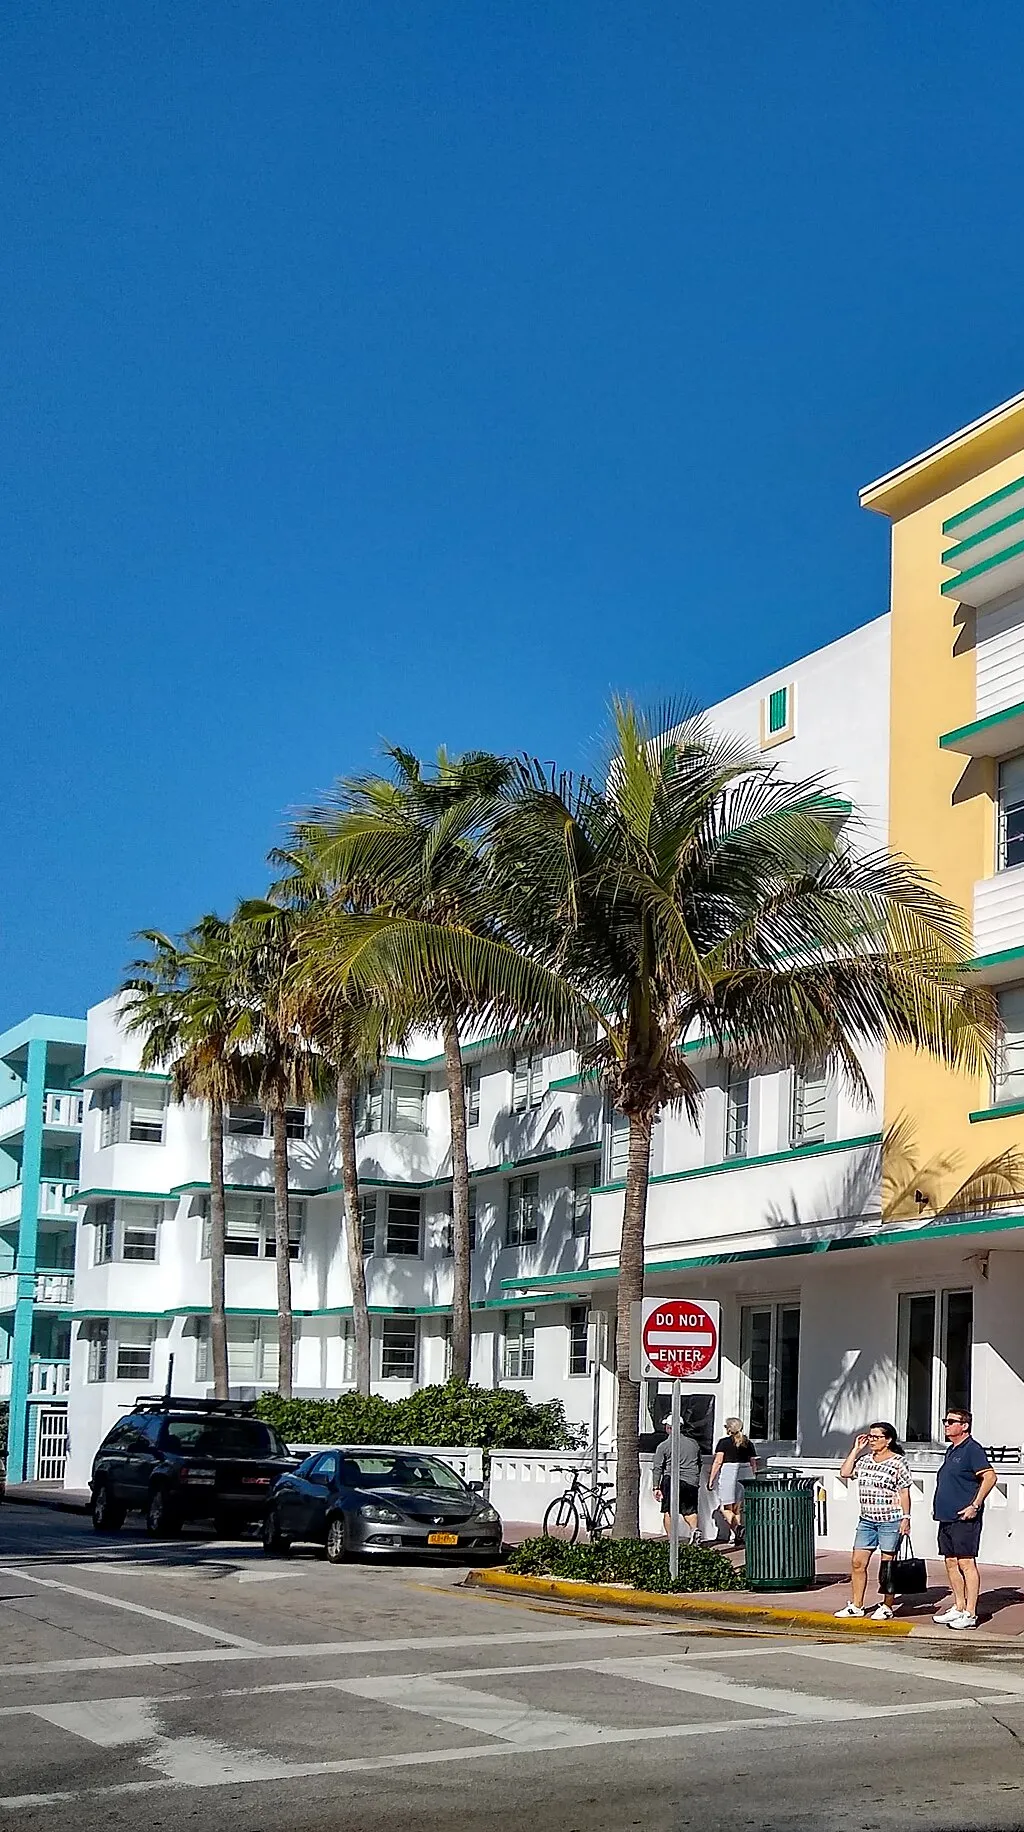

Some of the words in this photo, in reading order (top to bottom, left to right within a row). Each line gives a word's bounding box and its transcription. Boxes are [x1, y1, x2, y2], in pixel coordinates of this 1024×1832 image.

[656, 1313, 674, 1325] DO
[679, 1314, 705, 1326] NOT
[660, 1349, 701, 1361] ENTER
